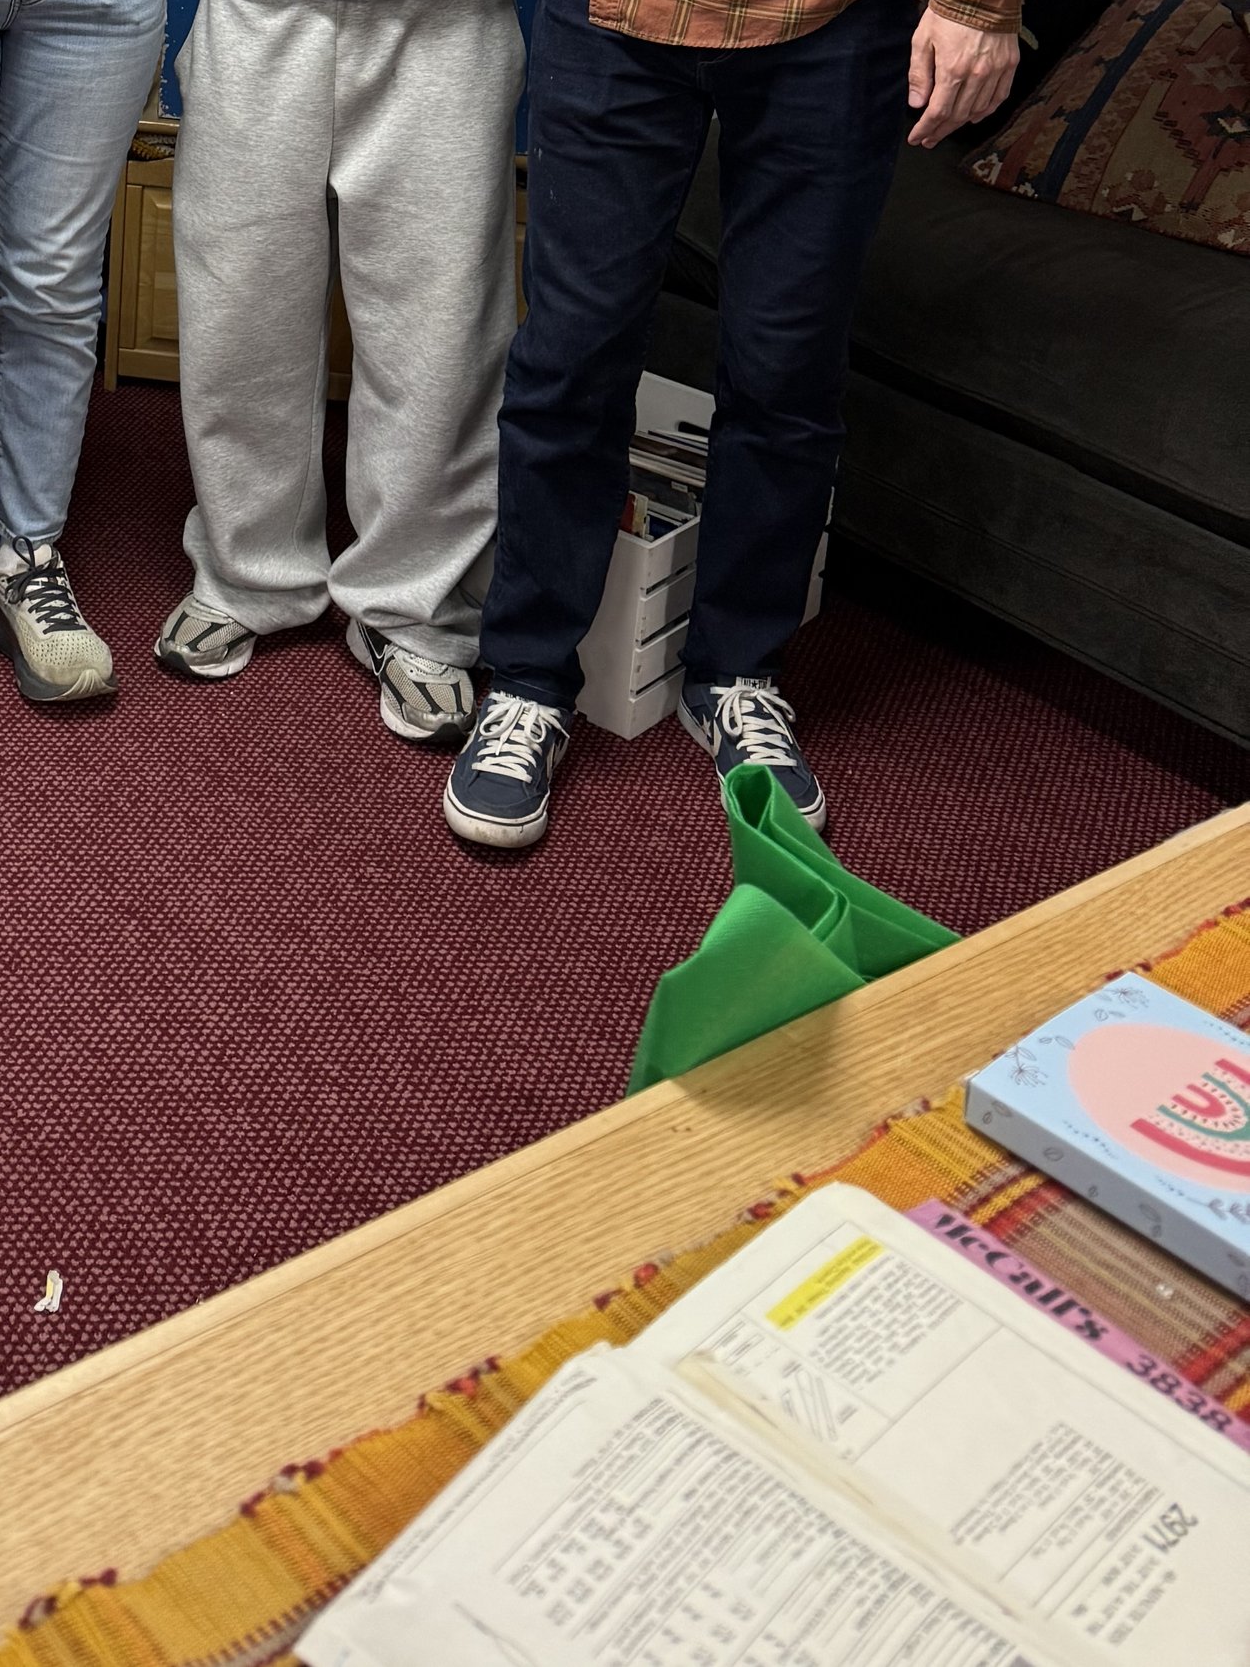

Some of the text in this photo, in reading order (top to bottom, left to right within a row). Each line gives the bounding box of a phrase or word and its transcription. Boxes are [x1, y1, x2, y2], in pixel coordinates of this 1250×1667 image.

[934, 1213, 1109, 1342] McCall's
[1126, 1354, 1234, 1432] 3838
[1149, 1503, 1199, 1555] 2971
